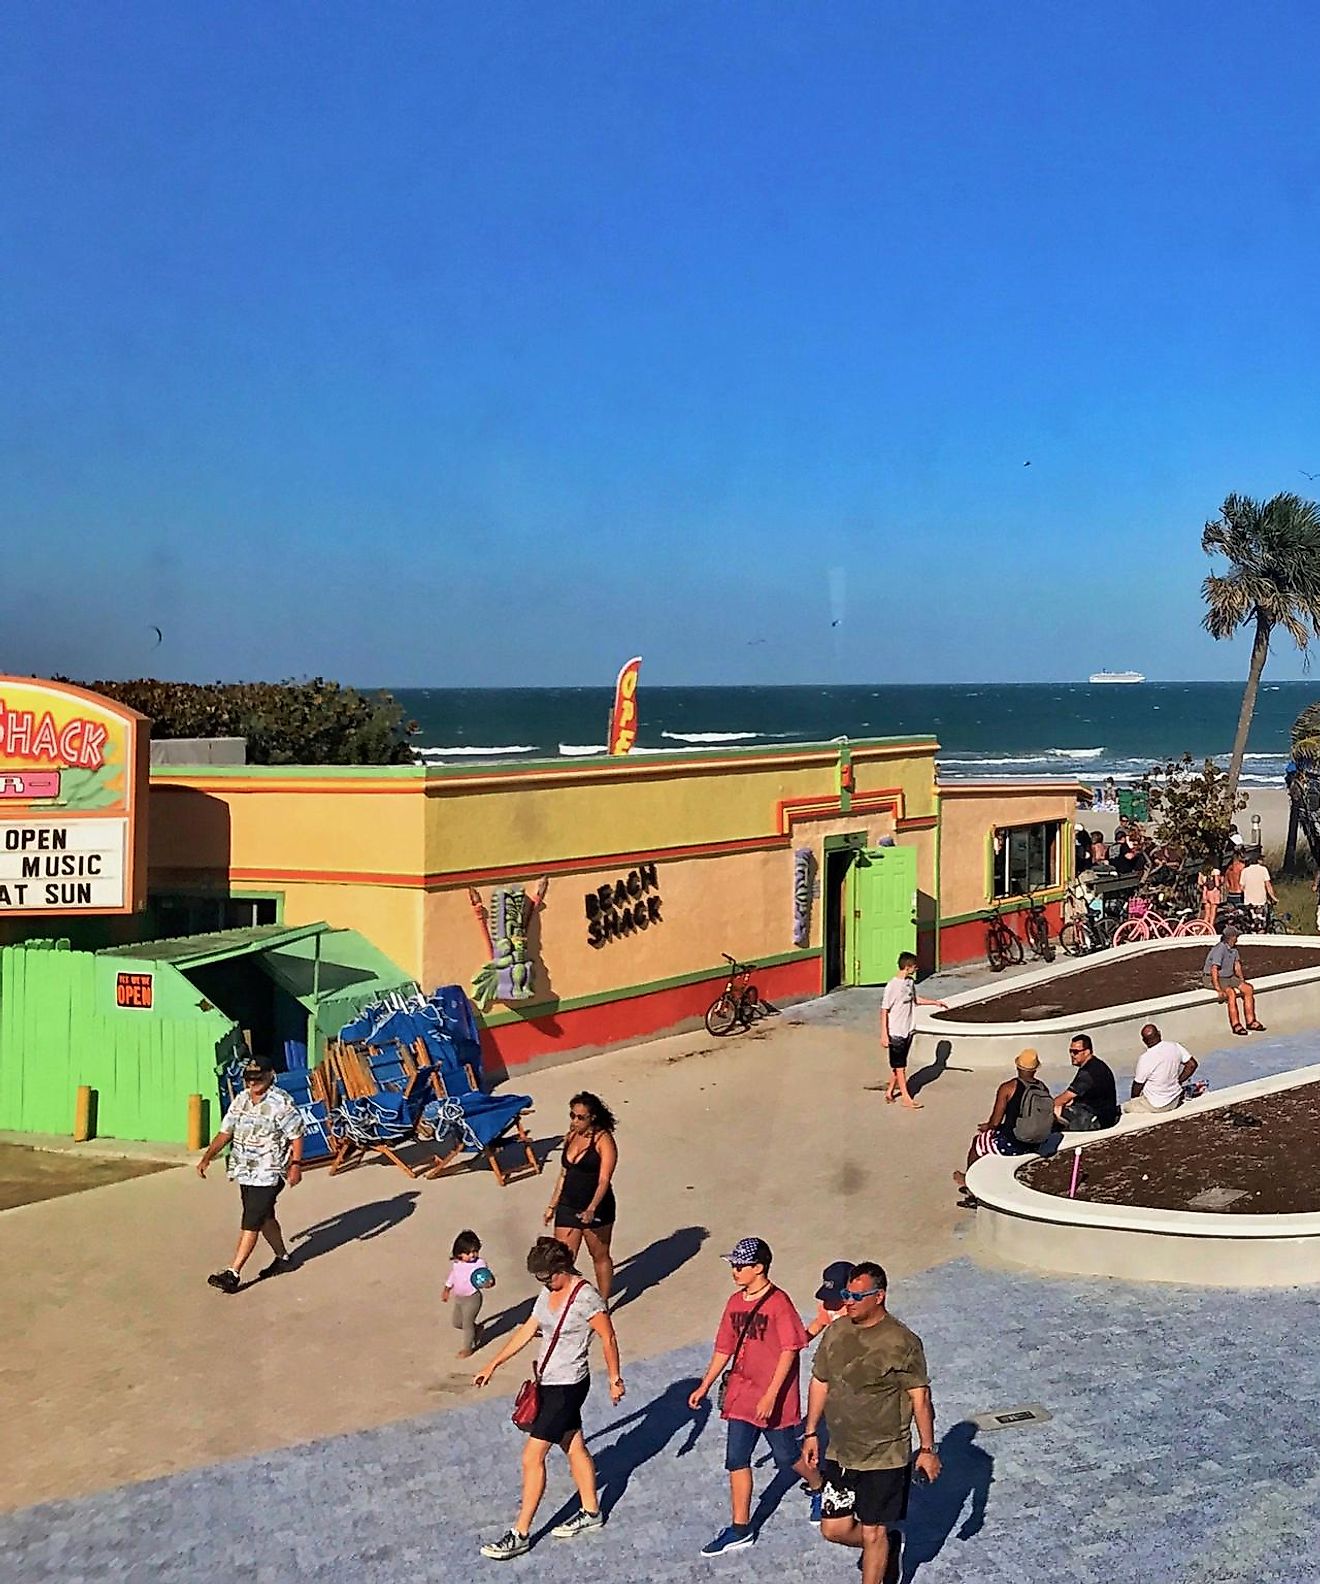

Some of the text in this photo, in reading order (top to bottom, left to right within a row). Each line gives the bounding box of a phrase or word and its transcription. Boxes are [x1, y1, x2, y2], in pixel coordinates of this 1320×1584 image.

[0, 700, 107, 766] HACK
[5, 828, 67, 851] OPEN
[22, 854, 102, 878] MUSIC
[45, 883, 92, 905] SUN
[584, 863, 660, 921] BEACH
[587, 896, 664, 950] SHACK
[117, 985, 151, 1006] OPEN
